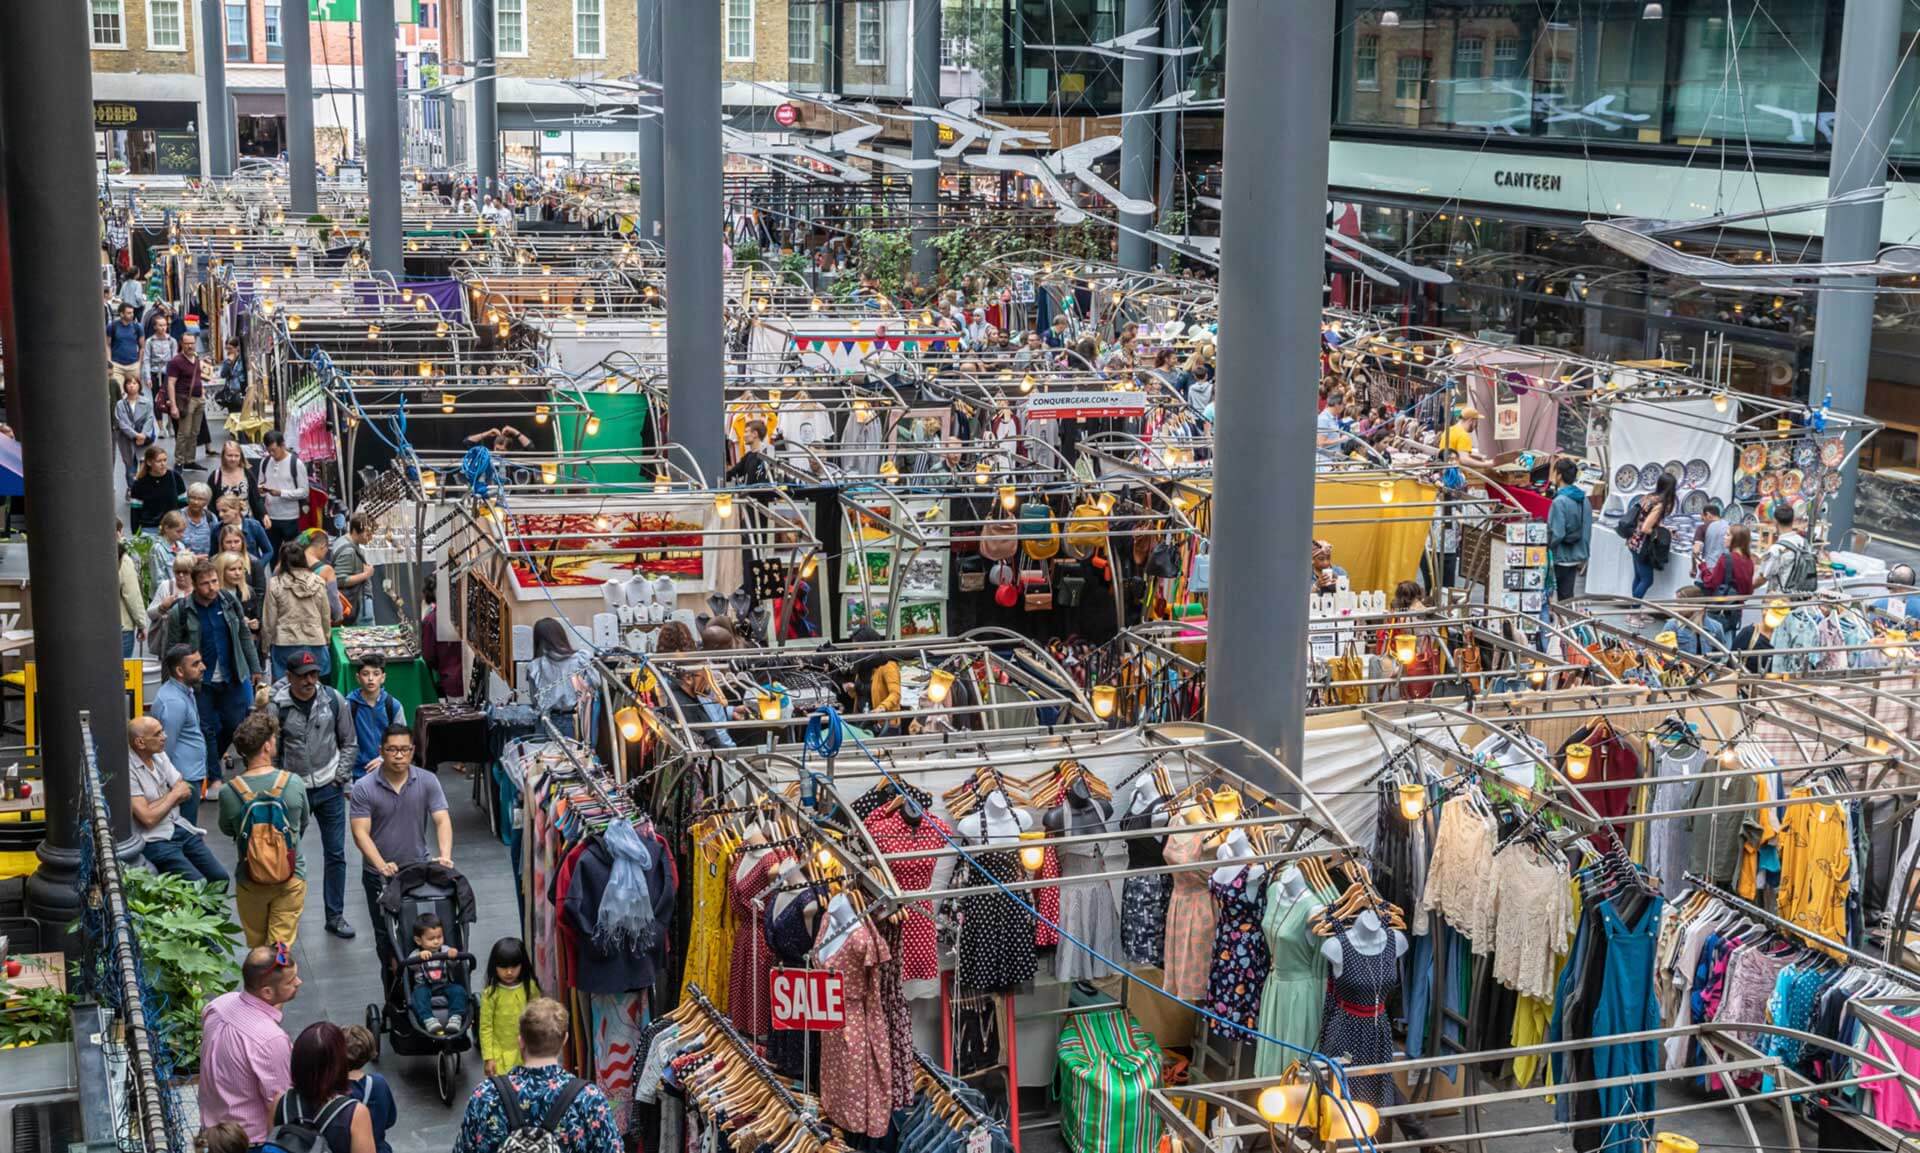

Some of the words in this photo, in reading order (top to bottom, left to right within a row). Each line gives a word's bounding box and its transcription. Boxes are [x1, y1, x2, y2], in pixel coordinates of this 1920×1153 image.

[1494, 170, 1562, 192] CANTEEN
[1033, 396, 1108, 406] CONQUERGEAR.COM
[774, 975, 843, 1021] SALE
